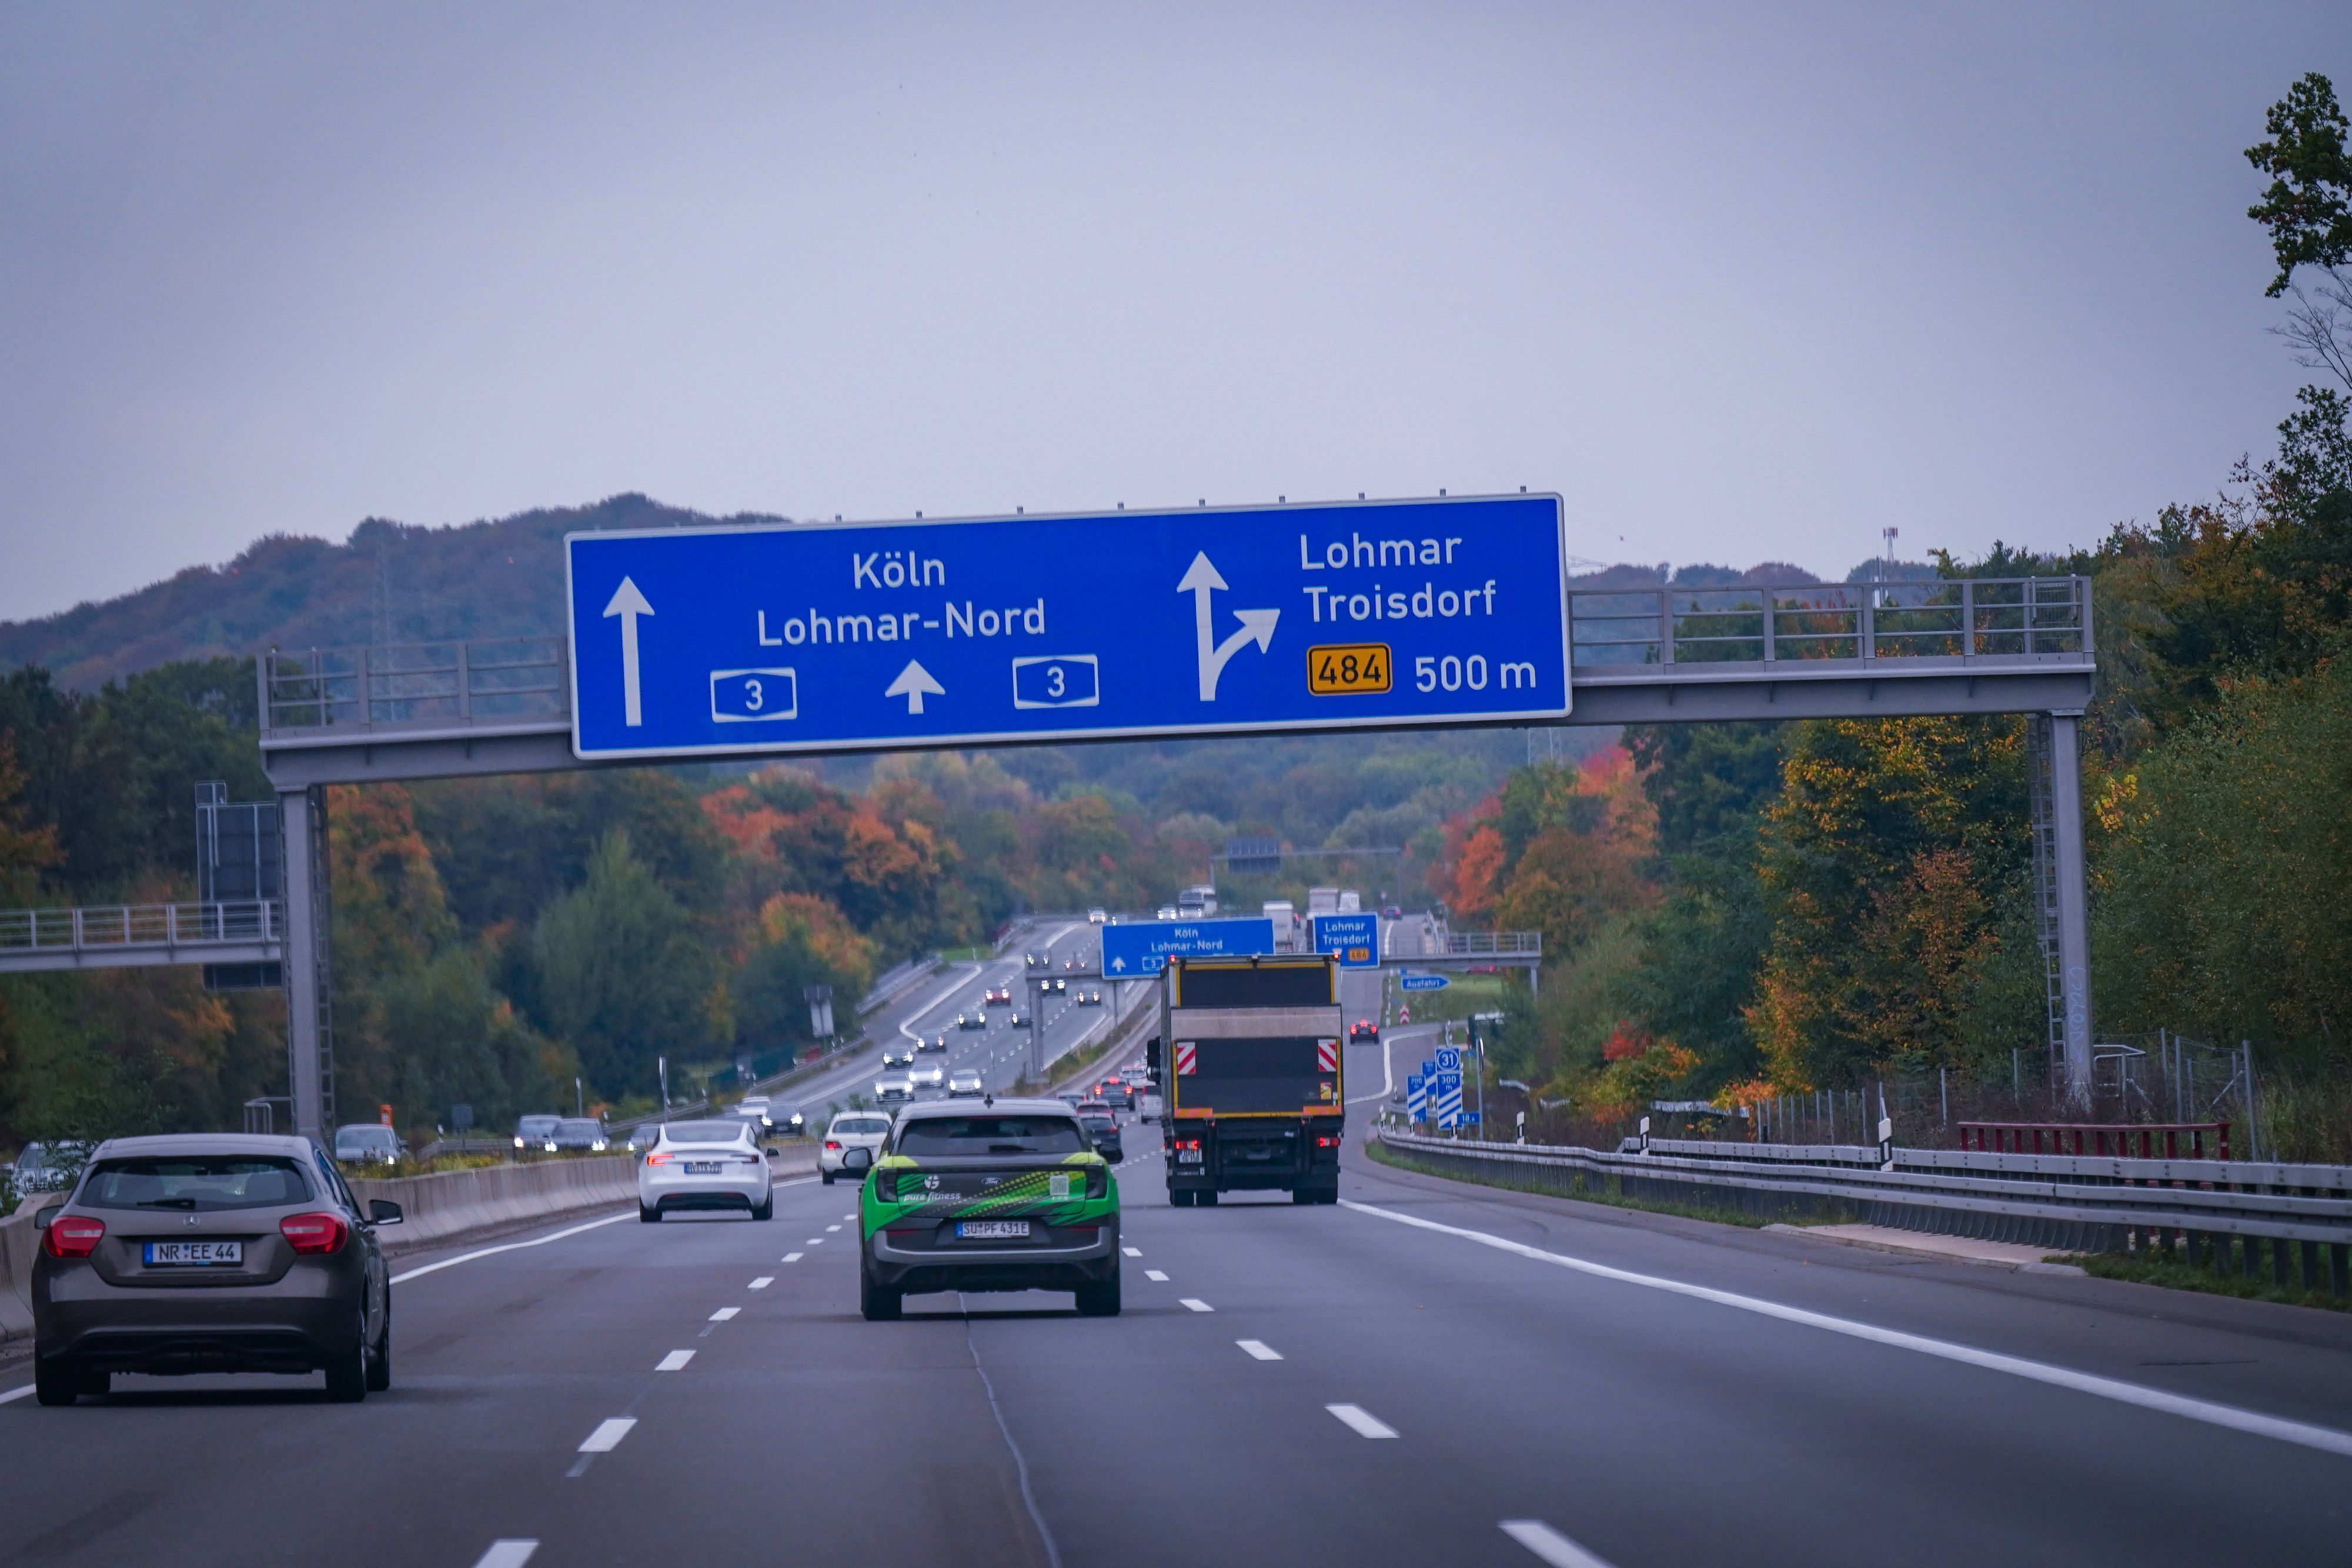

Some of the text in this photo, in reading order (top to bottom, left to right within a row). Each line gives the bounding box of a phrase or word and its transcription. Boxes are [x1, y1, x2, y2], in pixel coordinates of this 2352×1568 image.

[1300, 532, 1463, 570] Lohmar
[853, 550, 946, 589] Köln
[1302, 579, 1497, 623] Troisdorf
[758, 597, 1045, 647] Lohmar-Nord
[1318, 654, 1382, 685] 484
[1415, 655, 1536, 693] 500 m
[1047, 666, 1065, 697] 3
[745, 679, 763, 711] 3
[1174, 928, 1198, 938] Köln
[1325, 921, 1365, 932] Lohmar
[1324, 932, 1371, 945] Troisdorf
[1151, 940, 1223, 952] Lohmar-Nord
[1406, 978, 1440, 989] Ausfahrt
[1441, 1053, 1454, 1066] 31
[1441, 1075, 1456, 1085] 300
[903, 1191, 961, 1202] pure fitness
[963, 1222, 1028, 1234] SU PF 431E
[159, 1244, 235, 1260] NR EE 44
